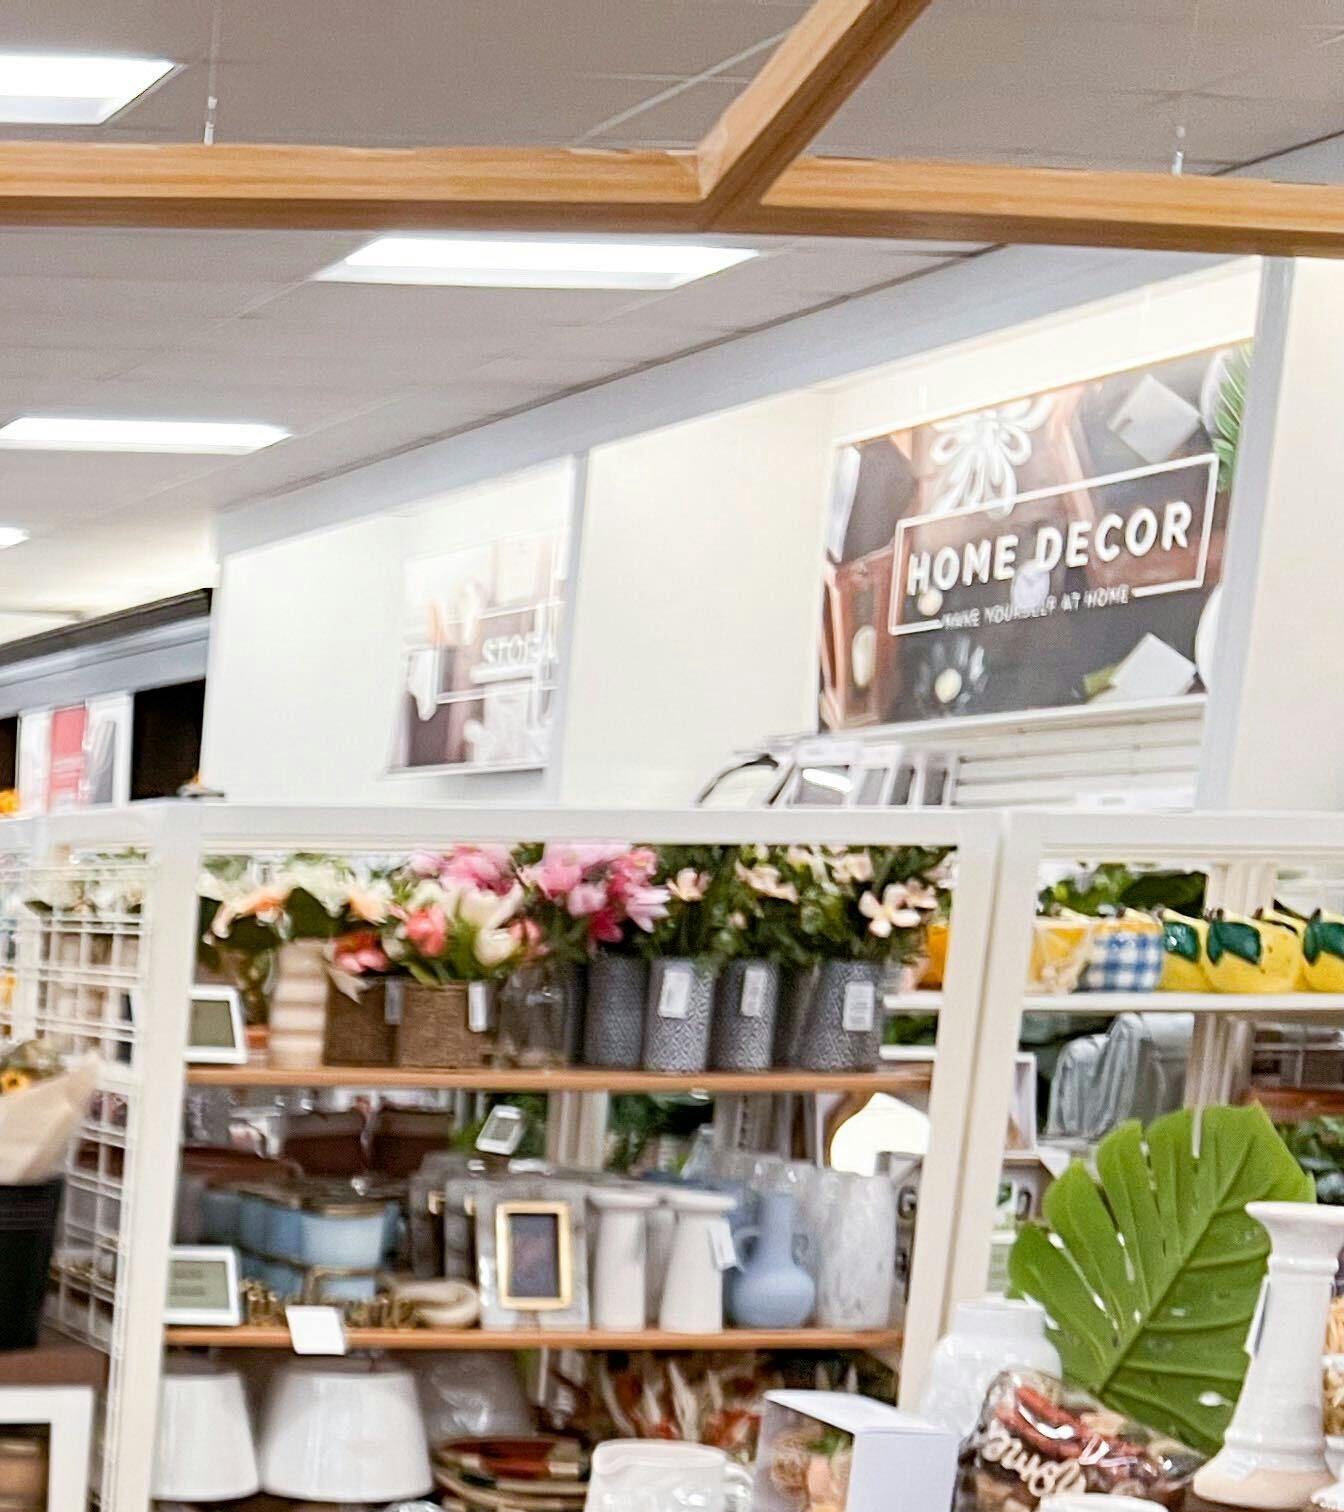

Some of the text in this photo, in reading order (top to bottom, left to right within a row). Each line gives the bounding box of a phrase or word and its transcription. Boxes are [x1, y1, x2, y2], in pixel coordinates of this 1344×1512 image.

[905, 500, 1193, 597] HOME DECOR
[1085, 584, 1130, 608] HOME
